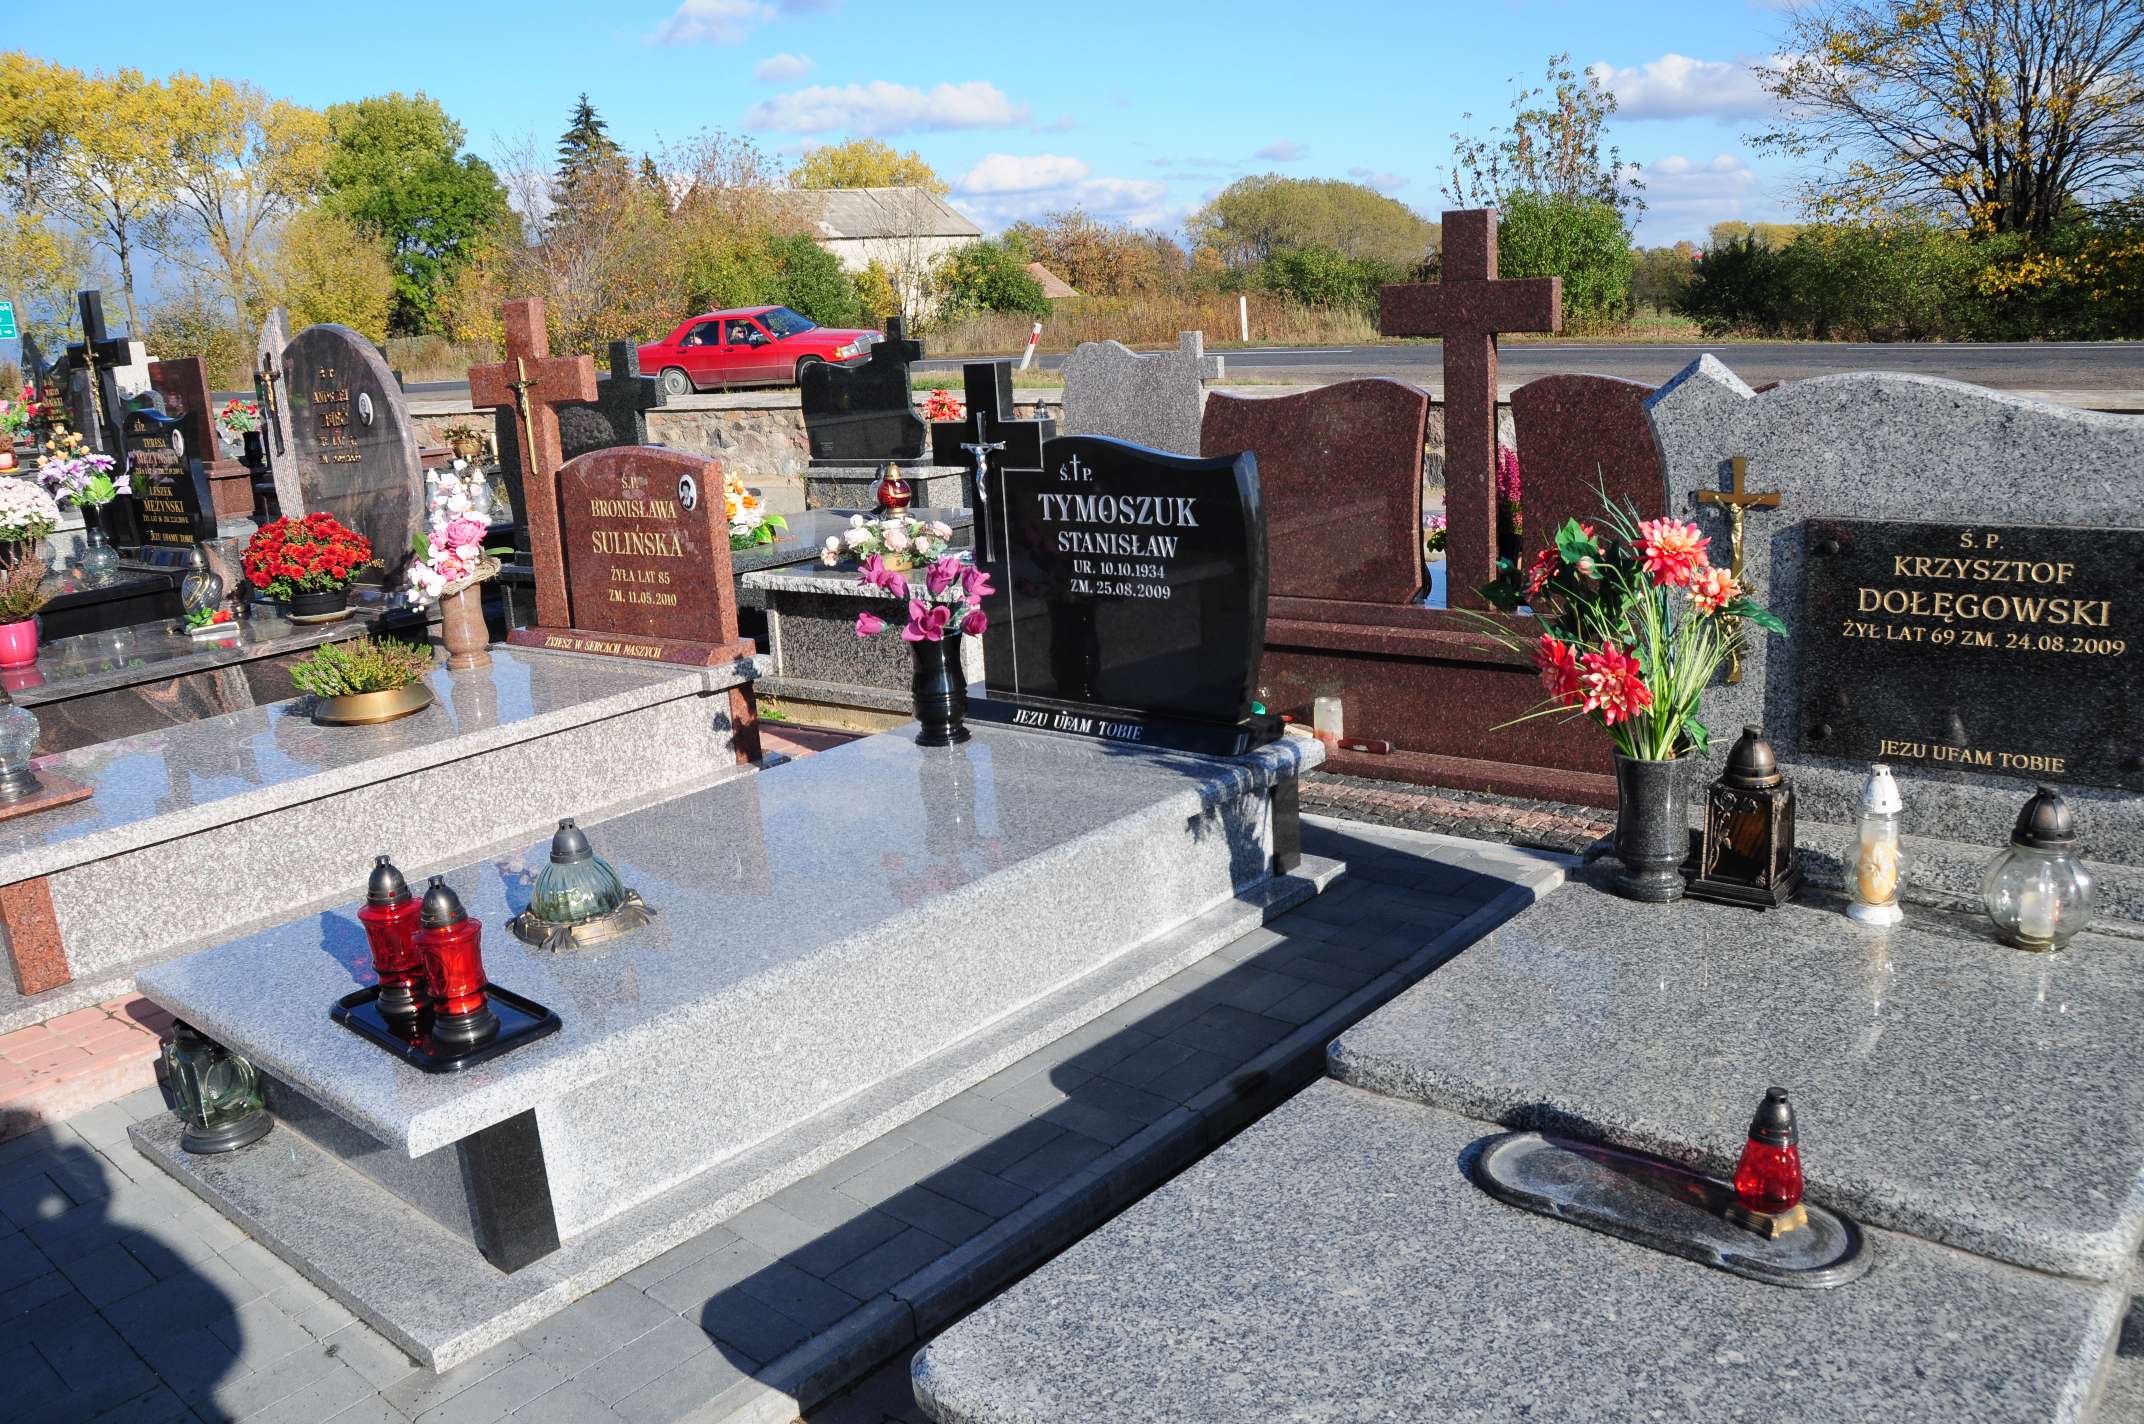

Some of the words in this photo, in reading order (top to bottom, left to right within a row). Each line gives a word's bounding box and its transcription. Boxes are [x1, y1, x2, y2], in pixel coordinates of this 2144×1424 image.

[591, 499, 678, 519] BRONISŁAWA
[1038, 493, 1200, 528] TYMOSZUK
[591, 524, 684, 557] SULIŃSKA
[1058, 530, 1179, 558] STANISŁAW
[1960, 529, 1979, 549] Ś.
[1986, 533, 2004, 549] P.
[610, 565, 635, 583] ŻYŁA
[638, 570, 656, 584] LAT
[658, 571, 671, 584] 85
[1073, 559, 1096, 574] UR.
[1100, 561, 1165, 579] 10.10.1934
[1893, 555, 2075, 585] KRZYSZTOF
[608, 588, 626, 602] ZM.
[628, 591, 677, 606] 11.05.2010
[1070, 579, 1094, 594] ZM.
[1096, 580, 1171, 599] 25.08.2009
[1857, 587, 2112, 627] DOŁĘGOWSKI
[575, 639, 584, 650] W
[585, 640, 621, 655] SERCACH
[623, 643, 662, 658] NASZYCH
[1842, 619, 1881, 640] ŻYŁ
[1886, 624, 1926, 641] LAT
[1931, 627, 1956, 645] 69
[1960, 630, 1999, 648] ZM.
[2005, 632, 2126, 656] 24.08.2009
[1013, 708, 1049, 727] JEZU
[1053, 713, 1093, 734] UFAM
[1099, 720, 1144, 740] TOBIE
[1878, 739, 1927, 758] JEZU
[1932, 745, 1993, 766] UFAM
[1998, 752, 2066, 773] TOBIE
